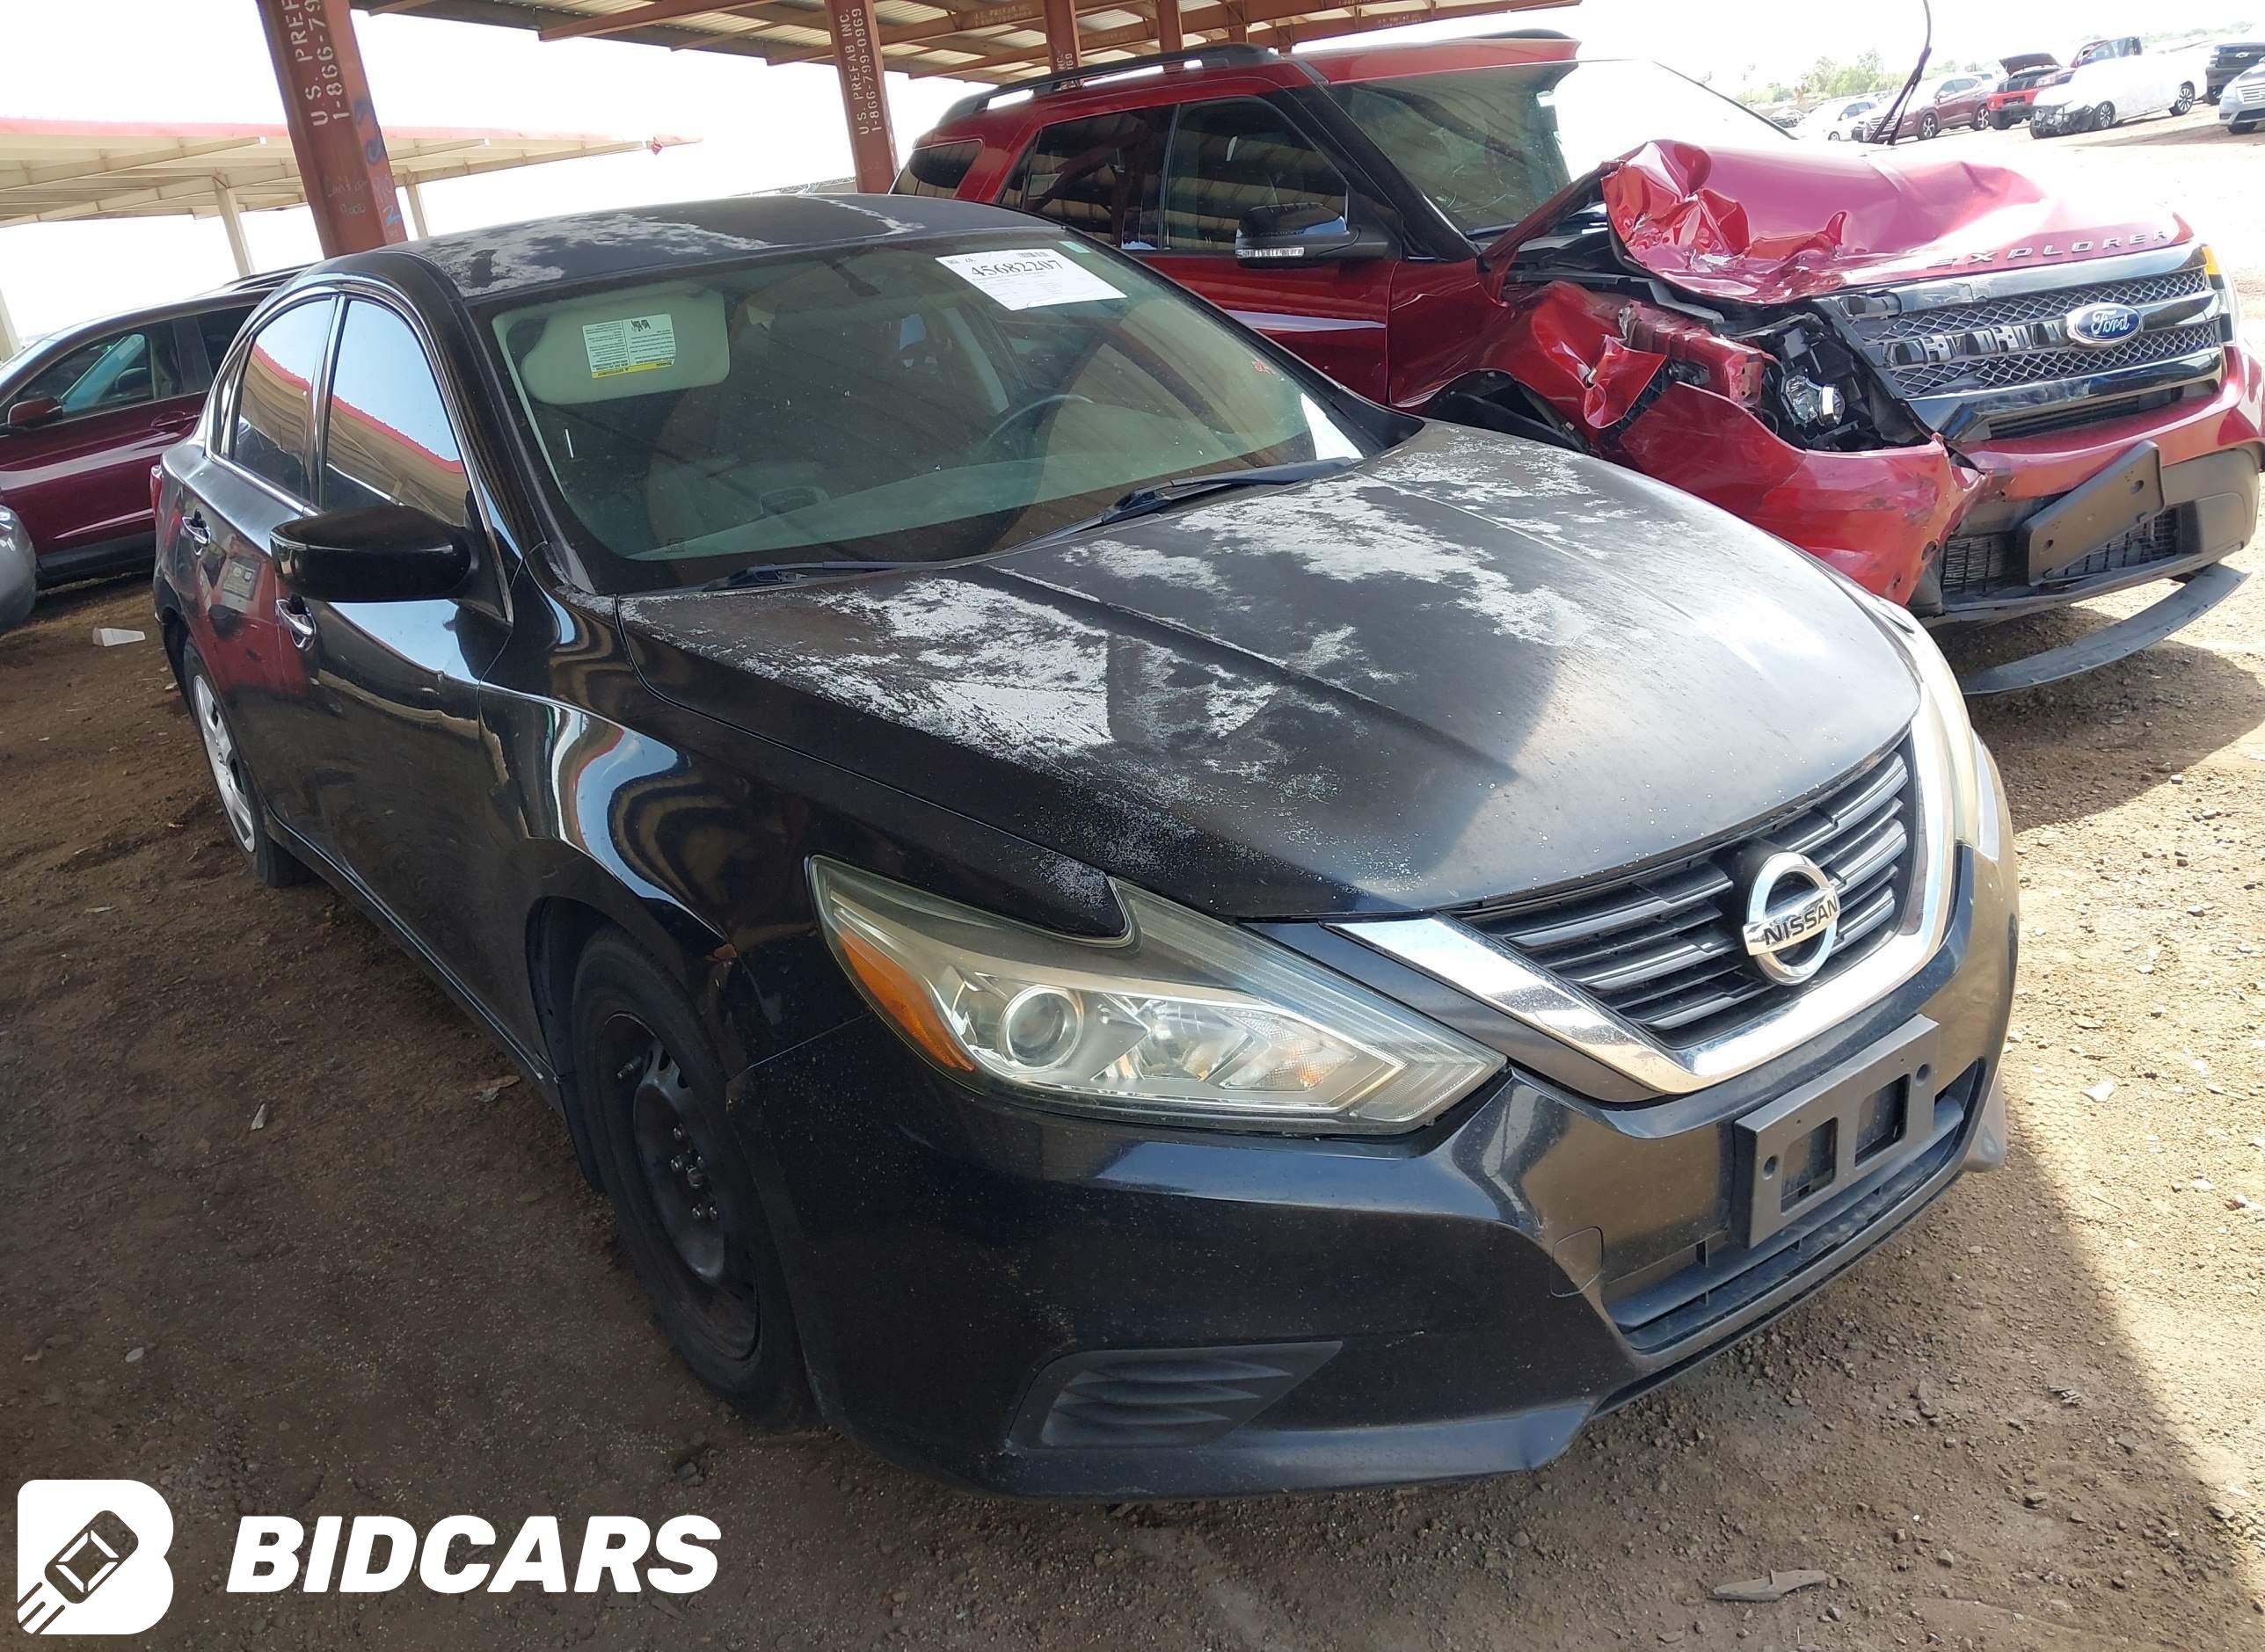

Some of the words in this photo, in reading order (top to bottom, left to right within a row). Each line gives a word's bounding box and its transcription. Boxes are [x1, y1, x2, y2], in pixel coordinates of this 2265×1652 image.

[839, 9, 853, 37] INC.
[845, 45, 864, 100] PREFAB
[851, 8, 883, 132] 1-866-799-0969
[305, 76, 329, 126] U.S.
[857, 107, 870, 135] U.S.
[972, 259, 1063, 276] 45682207
[1926, 230, 2168, 270] EXPLORER
[2090, 309, 2130, 335] Ford
[1763, 895, 1839, 946] NISSAN
